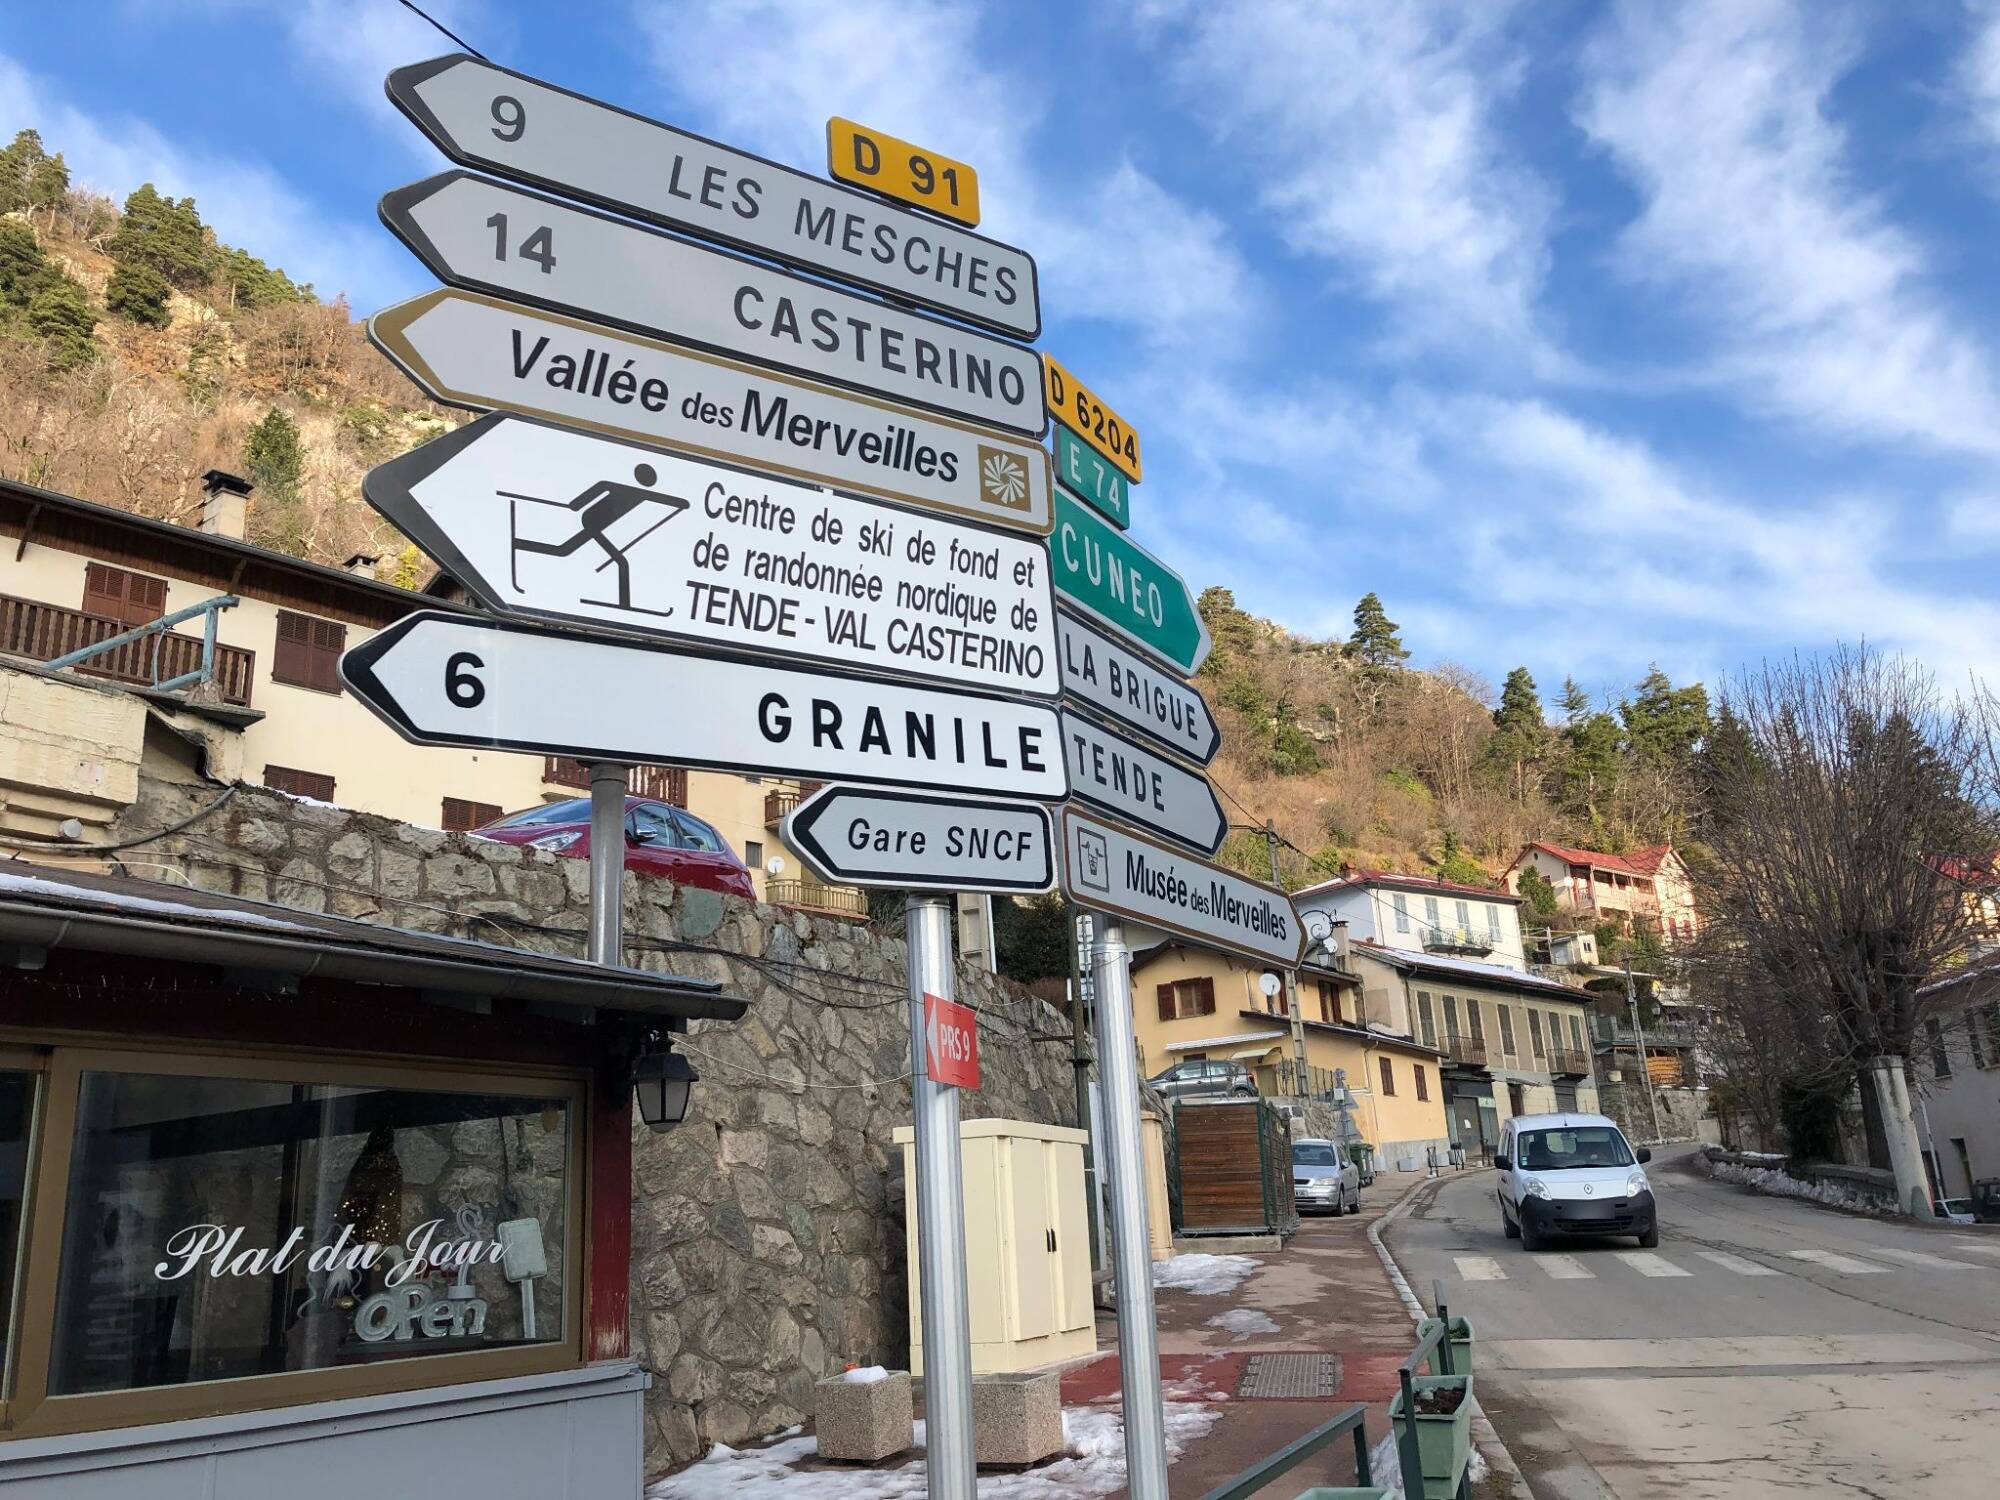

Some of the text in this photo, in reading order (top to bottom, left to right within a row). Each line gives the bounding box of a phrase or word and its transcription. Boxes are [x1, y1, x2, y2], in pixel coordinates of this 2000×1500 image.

[490, 95, 526, 143] 9
[853, 133, 961, 206] D 91
[486, 212, 557, 274] 14
[667, 155, 1018, 305] LES MESCHES
[733, 284, 1025, 406] CASTERINO
[511, 329, 959, 483] Vallée des Merveilles
[1051, 367, 1137, 469] D 6204
[1070, 441, 1120, 512] E 74
[704, 481, 1035, 588] Centre de ski de fond et
[1061, 522, 1163, 627] CUNEO
[693, 532, 1038, 633] de randonnée nordique de
[685, 581, 800, 638] TENDE
[824, 606, 876, 650] VAL
[886, 618, 1044, 679] CASTERINO
[444, 652, 486, 708] 6
[1065, 633, 1198, 740] LA BRIGUE
[757, 692, 1047, 773] GRANILE
[1073, 734, 1165, 812] TENDE
[848, 818, 1032, 861] Gare SNCF
[1126, 849, 1287, 941] Musée des Merveilles
[154, 1219, 513, 1288] Plat du Jour
